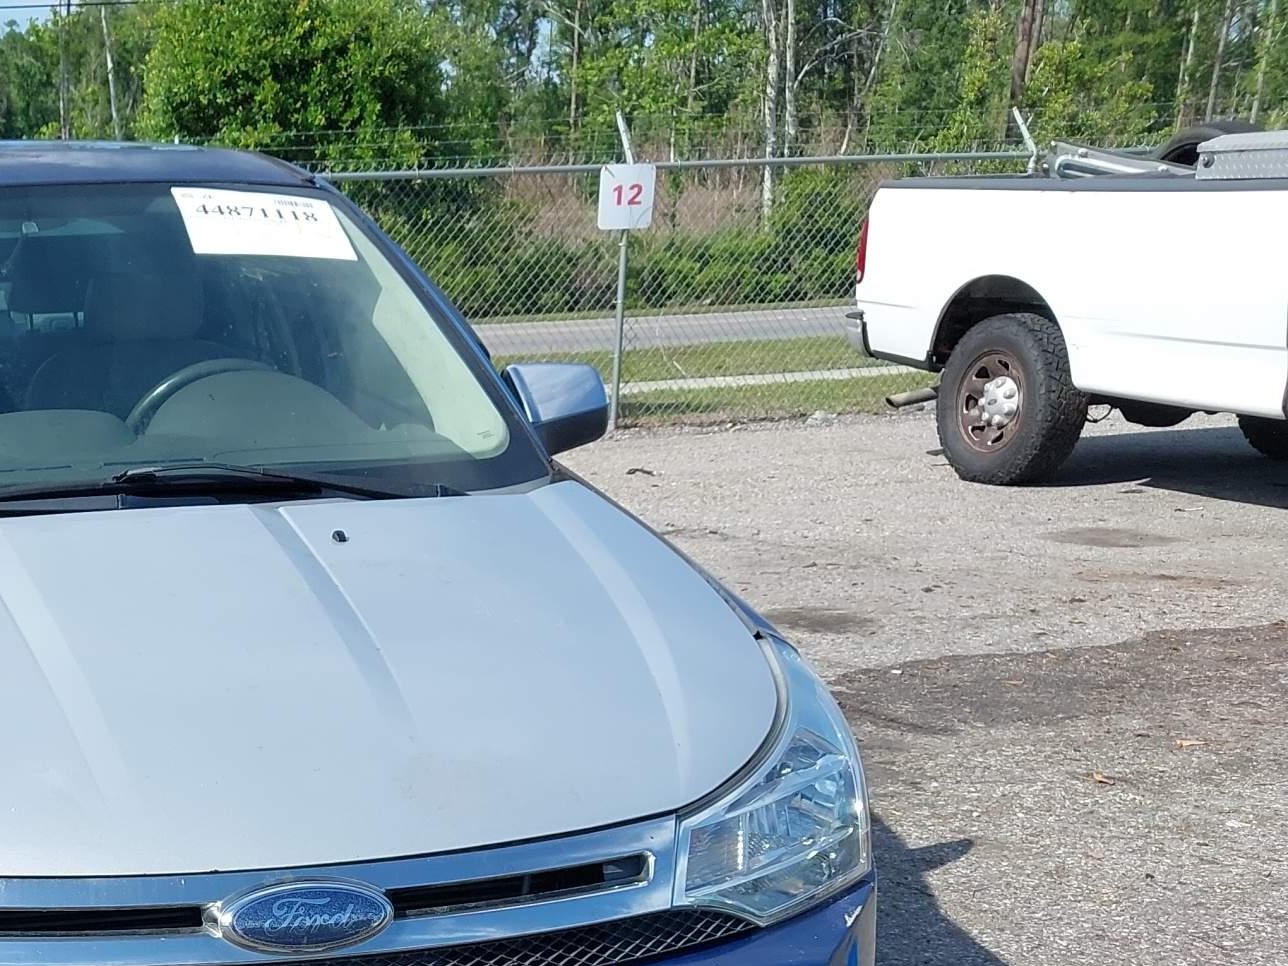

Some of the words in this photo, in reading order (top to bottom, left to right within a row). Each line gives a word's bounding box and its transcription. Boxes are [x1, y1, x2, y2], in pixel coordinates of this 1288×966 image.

[613, 184, 643, 206] 12
[195, 203, 319, 222] 44871118
[264, 897, 355, 934] Ford
